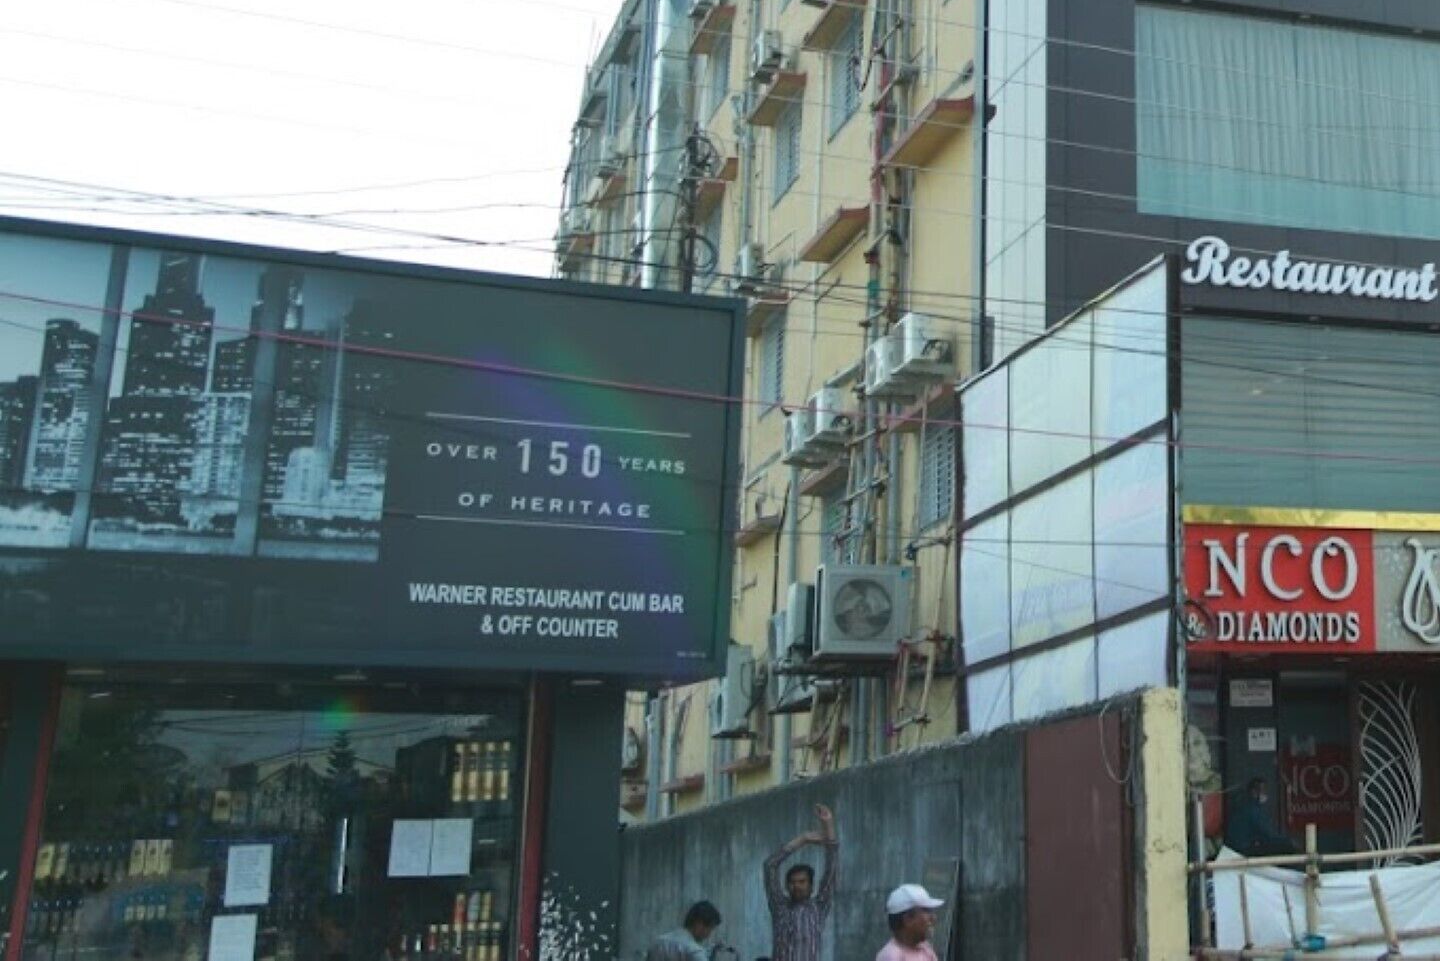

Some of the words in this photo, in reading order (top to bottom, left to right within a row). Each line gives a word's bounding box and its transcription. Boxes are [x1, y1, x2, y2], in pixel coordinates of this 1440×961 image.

[1181, 236, 1439, 302] Restaurant
[426, 442, 498, 461] OVER
[516, 438, 602, 479] 150
[618, 456, 687, 475] YEARS
[458, 493, 494, 508] OF
[511, 496, 651, 519] HERITAGE
[1186, 532, 1359, 601] NCO
[408, 582, 488, 606] WARNER
[490, 586, 606, 612] RESTAURANT
[608, 591, 646, 613] CUM
[648, 593, 685, 614] BAR
[481, 614, 494, 635] &
[498, 614, 533, 636] OFF
[536, 616, 619, 640] COUNTER
[1217, 610, 1361, 643] DIAMONDS
